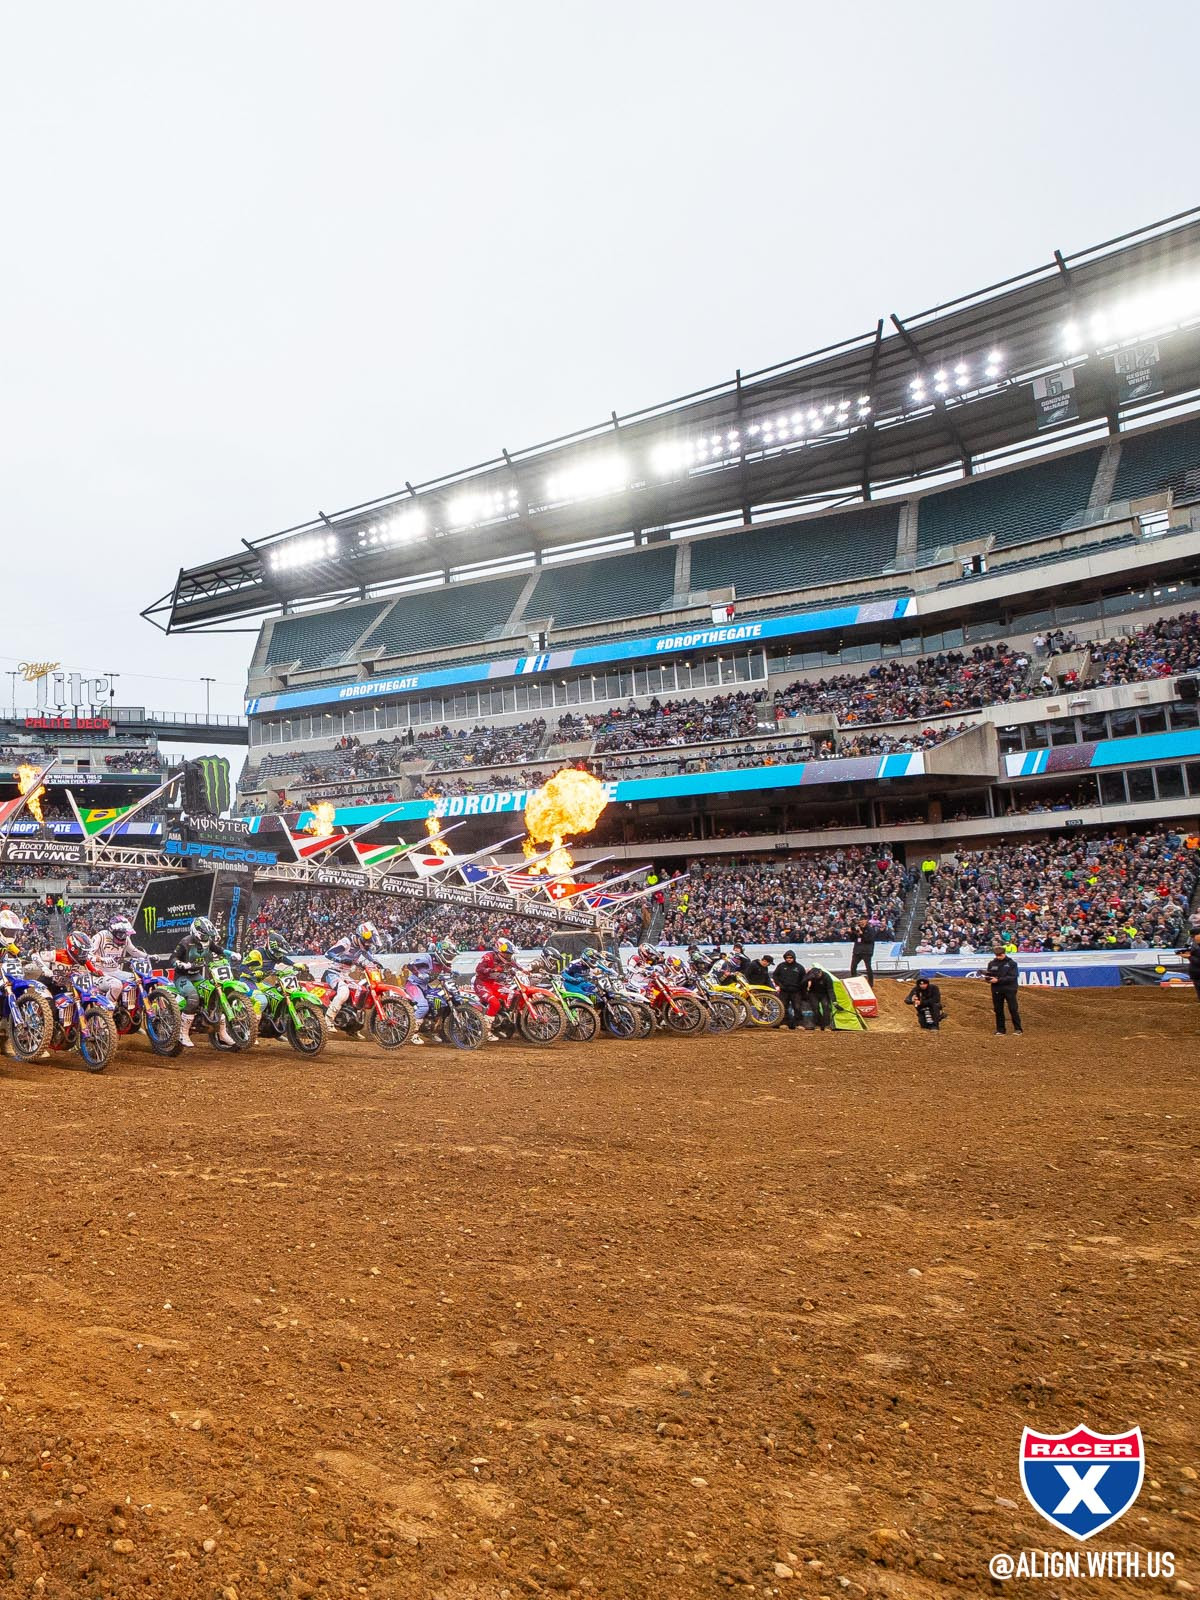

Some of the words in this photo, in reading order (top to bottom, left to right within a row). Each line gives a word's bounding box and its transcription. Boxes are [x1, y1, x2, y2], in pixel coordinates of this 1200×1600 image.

[1045, 374, 1063, 396] 5
[656, 624, 762, 651] #DROPTHEGATE
[18, 662, 61, 681] Miller
[36, 673, 108, 716] Lite
[339, 677, 419, 698] #DROPTHEGATE
[77, 718, 111, 729] DECK
[190, 814, 252, 835] MONSTER
[168, 832, 182, 841] AMA
[19, 842, 43, 850] ROCKY
[44, 842, 80, 852] MOUNTAIN
[165, 840, 279, 865] SUPERCROSS
[167, 903, 196, 913] MONSTER
[6, 963, 23, 975] 23
[217, 966, 231, 980] 9
[285, 977, 298, 989] 21
